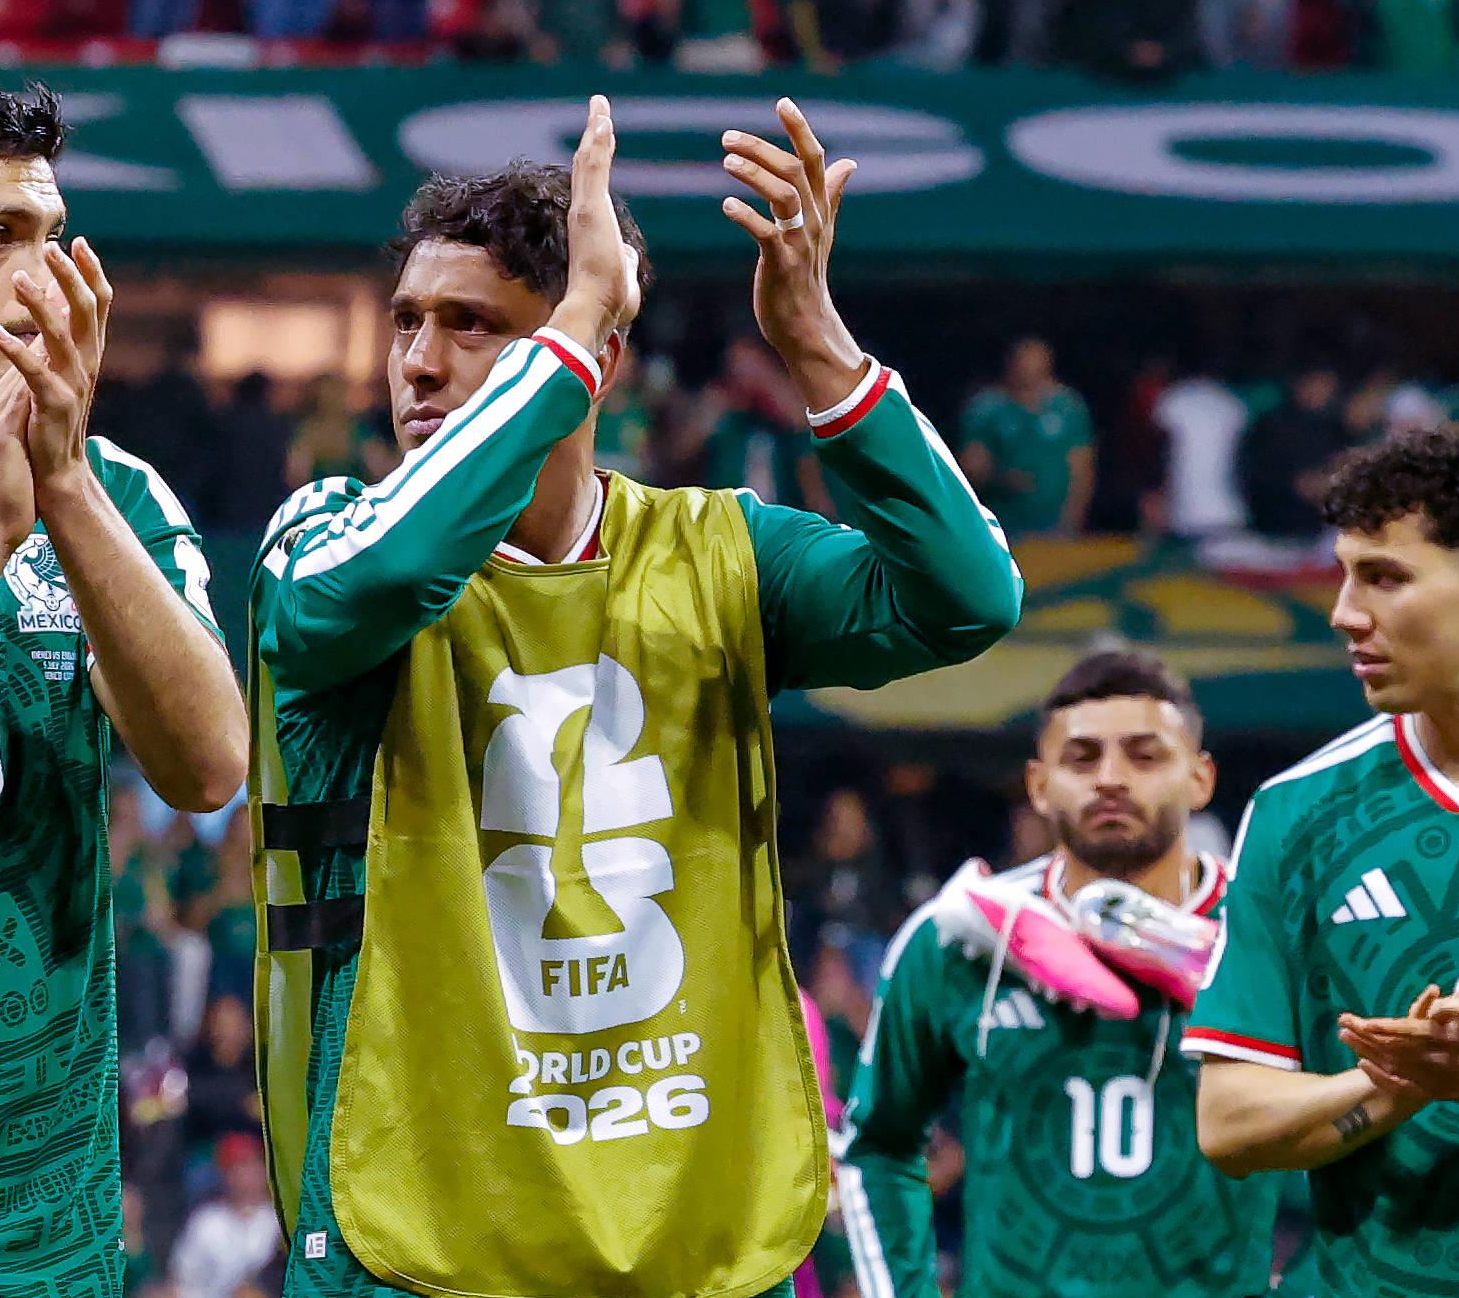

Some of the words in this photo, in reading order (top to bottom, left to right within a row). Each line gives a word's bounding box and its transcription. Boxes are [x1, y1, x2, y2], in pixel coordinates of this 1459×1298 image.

[540, 953, 629, 997] FIFA
[616, 1032, 701, 1075] CUP
[1063, 1074, 1155, 1179] 10
